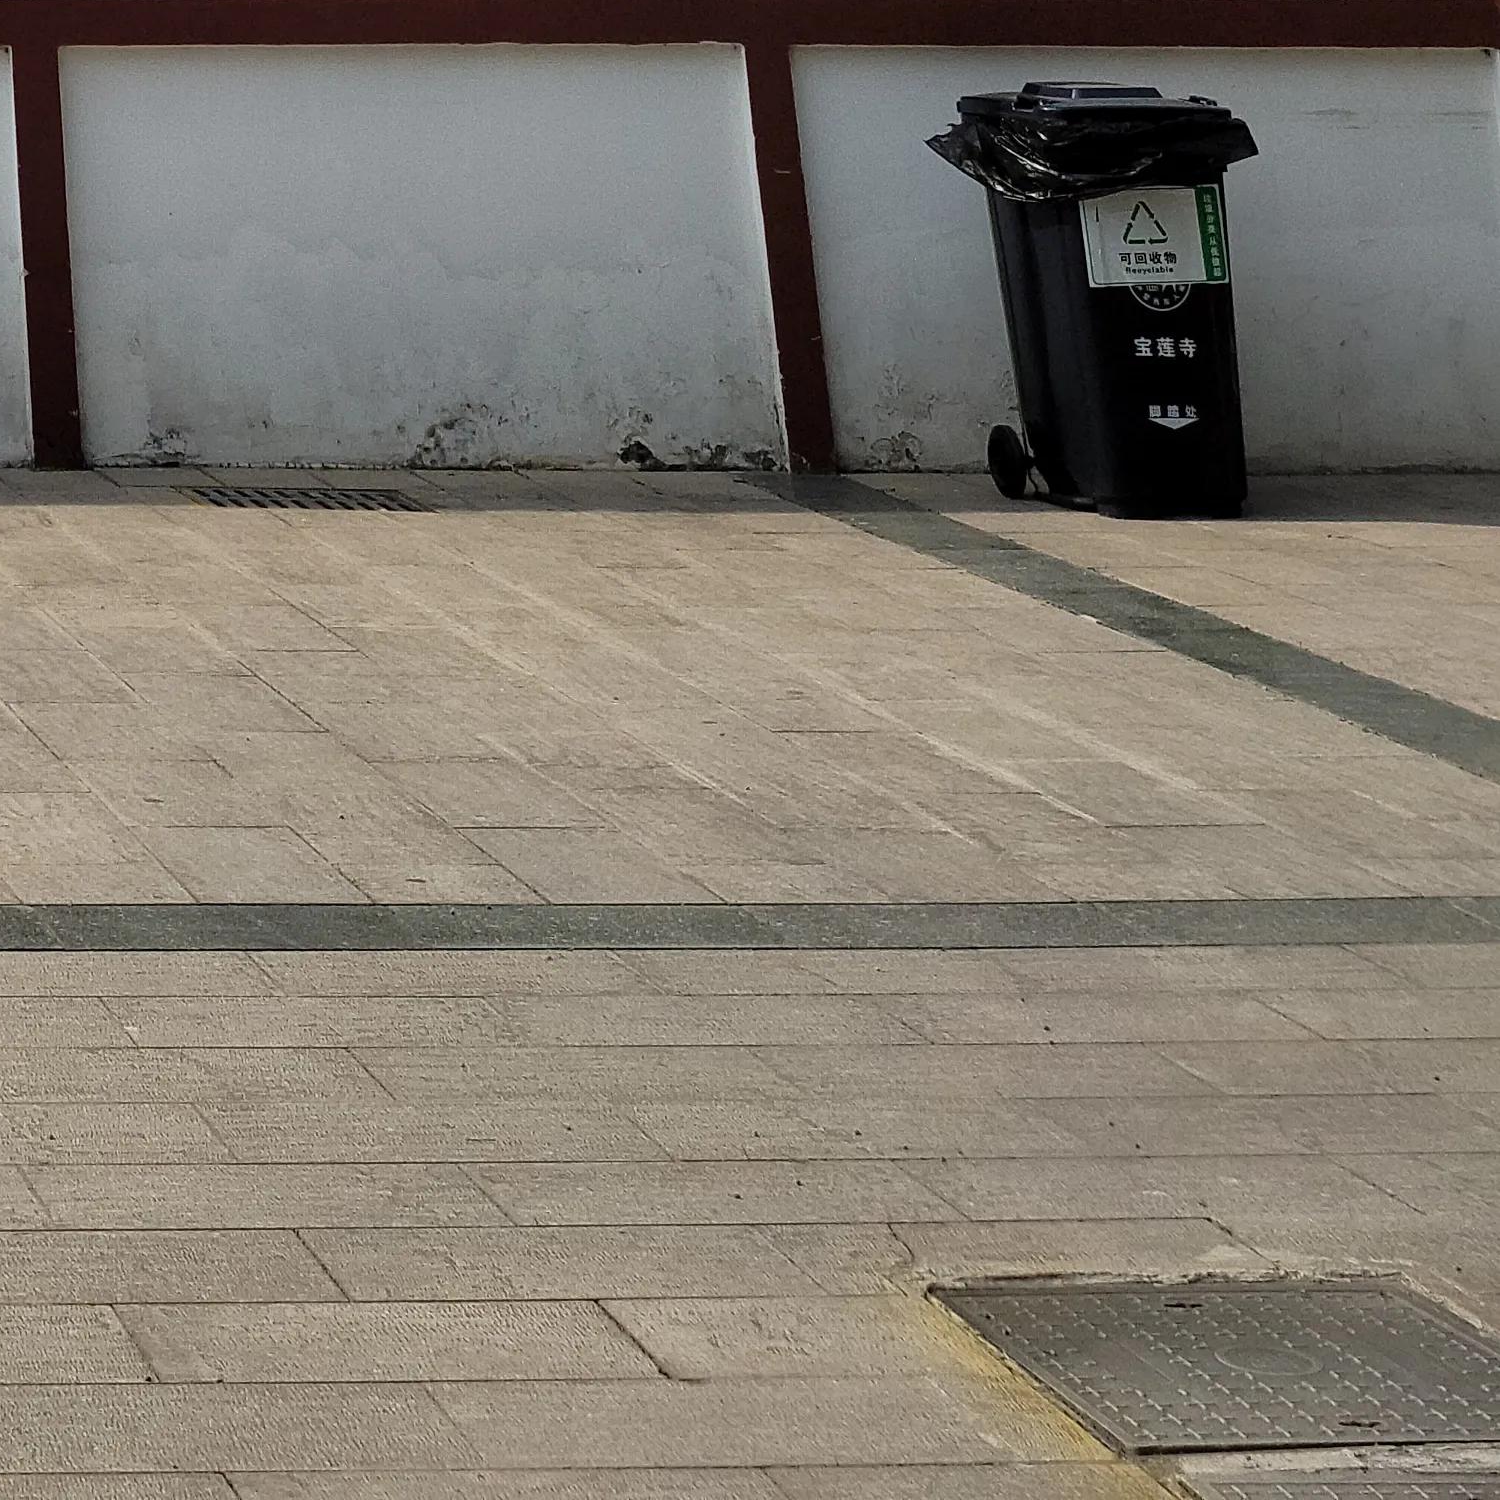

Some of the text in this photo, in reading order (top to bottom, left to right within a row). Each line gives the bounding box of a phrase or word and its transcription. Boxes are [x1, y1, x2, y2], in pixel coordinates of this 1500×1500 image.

[1118, 252, 1177, 265] 可回收物
[1125, 266, 1174, 275] Recyclable
[1133, 336, 1198, 358] 宝莲寺
